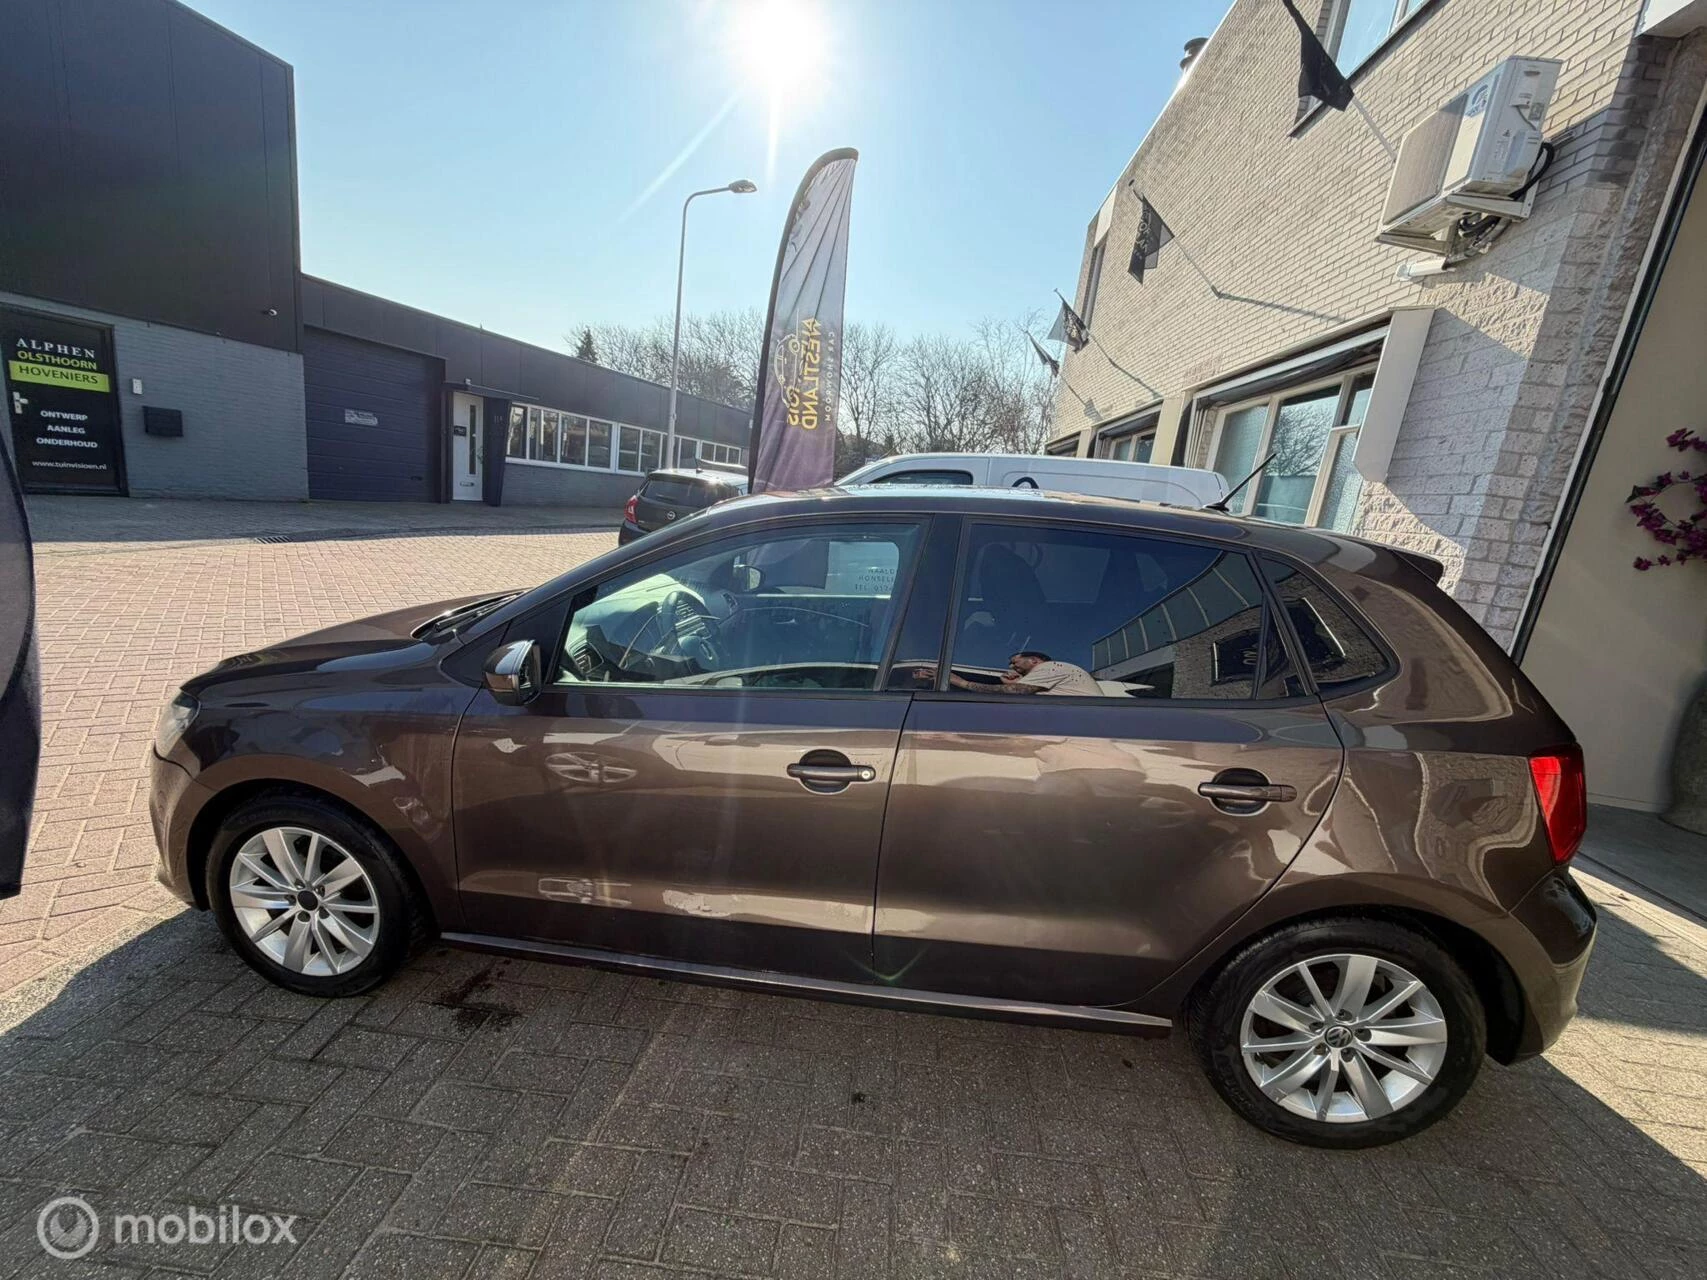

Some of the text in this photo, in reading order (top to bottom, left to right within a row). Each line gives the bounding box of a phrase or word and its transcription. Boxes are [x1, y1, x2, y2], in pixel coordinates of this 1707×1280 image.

[16, 338, 95, 358] ALPHEN
[17, 350, 97, 370] OLSTHOORN
[18, 365, 98, 384] HOVENIERS
[40, 410, 88, 420] ONTWERP
[47, 424, 86, 434] AANLEG
[36, 437, 98, 448] ONDERHOUD
